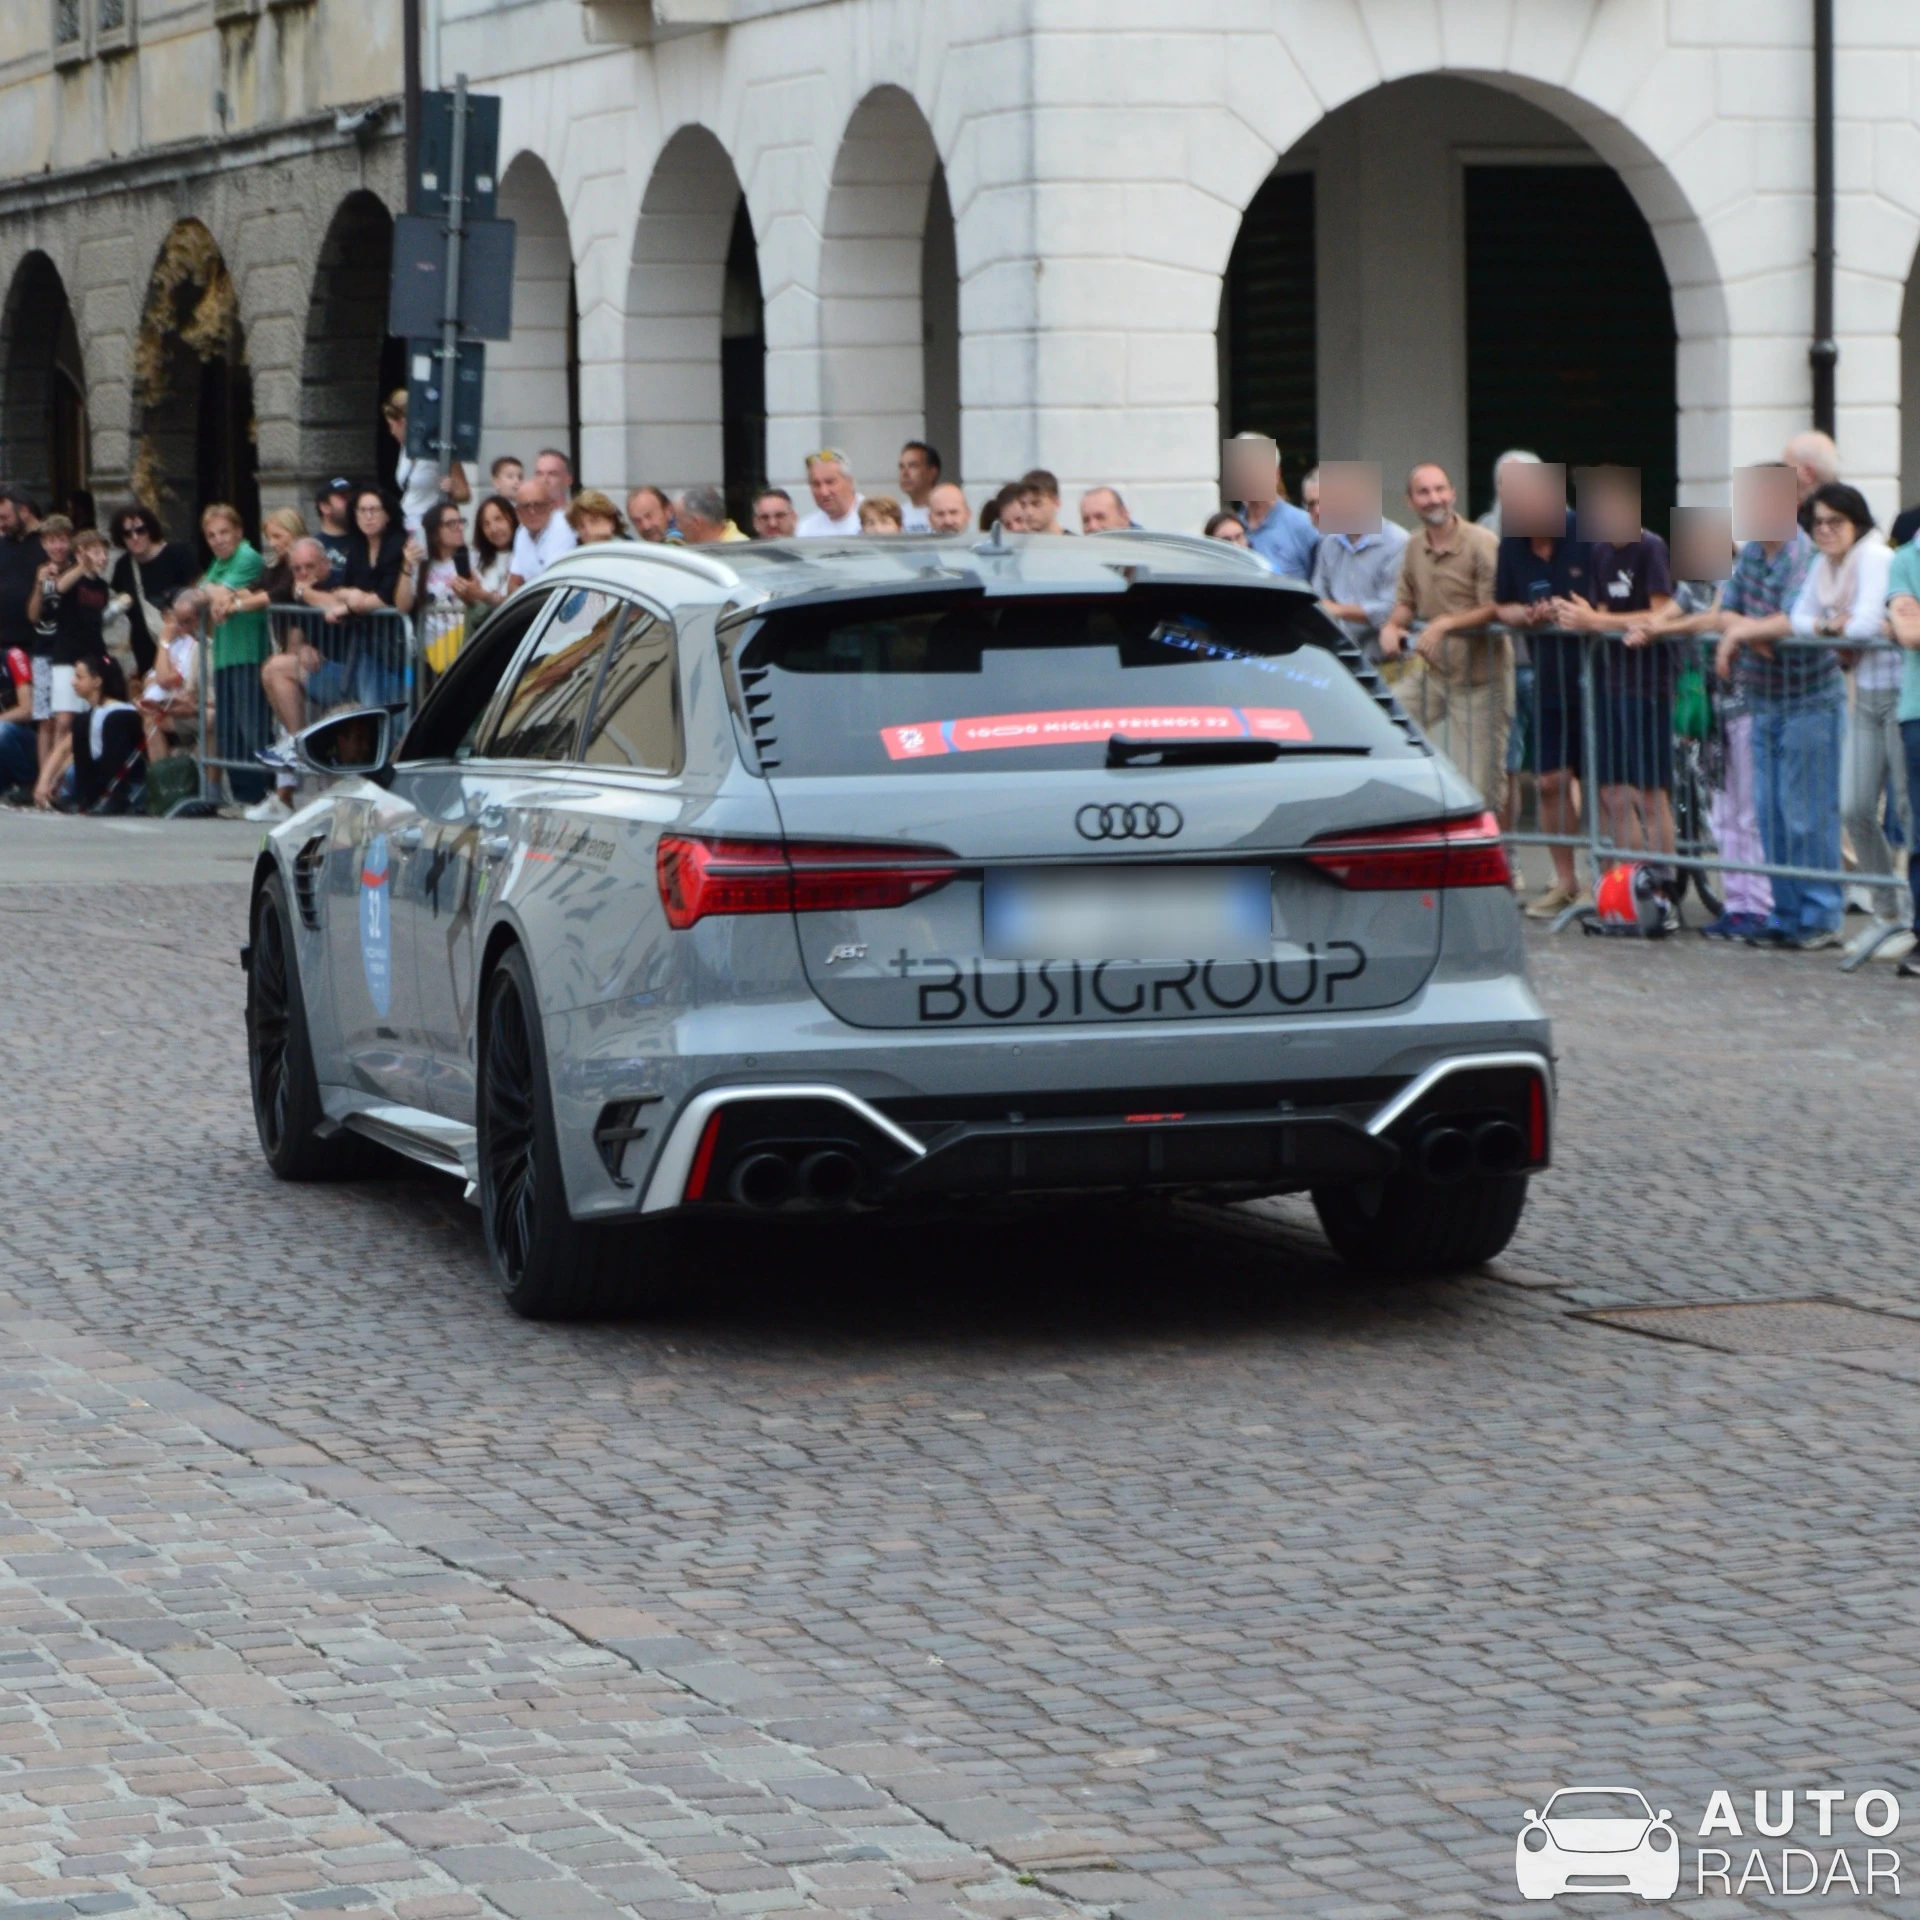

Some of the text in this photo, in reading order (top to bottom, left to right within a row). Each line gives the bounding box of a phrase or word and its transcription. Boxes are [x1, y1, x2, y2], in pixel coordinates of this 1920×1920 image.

[1043, 719, 1114, 733] MIGLIA
[1117, 715, 1201, 730] FRIENDS
[824, 943, 869, 965] ABT
